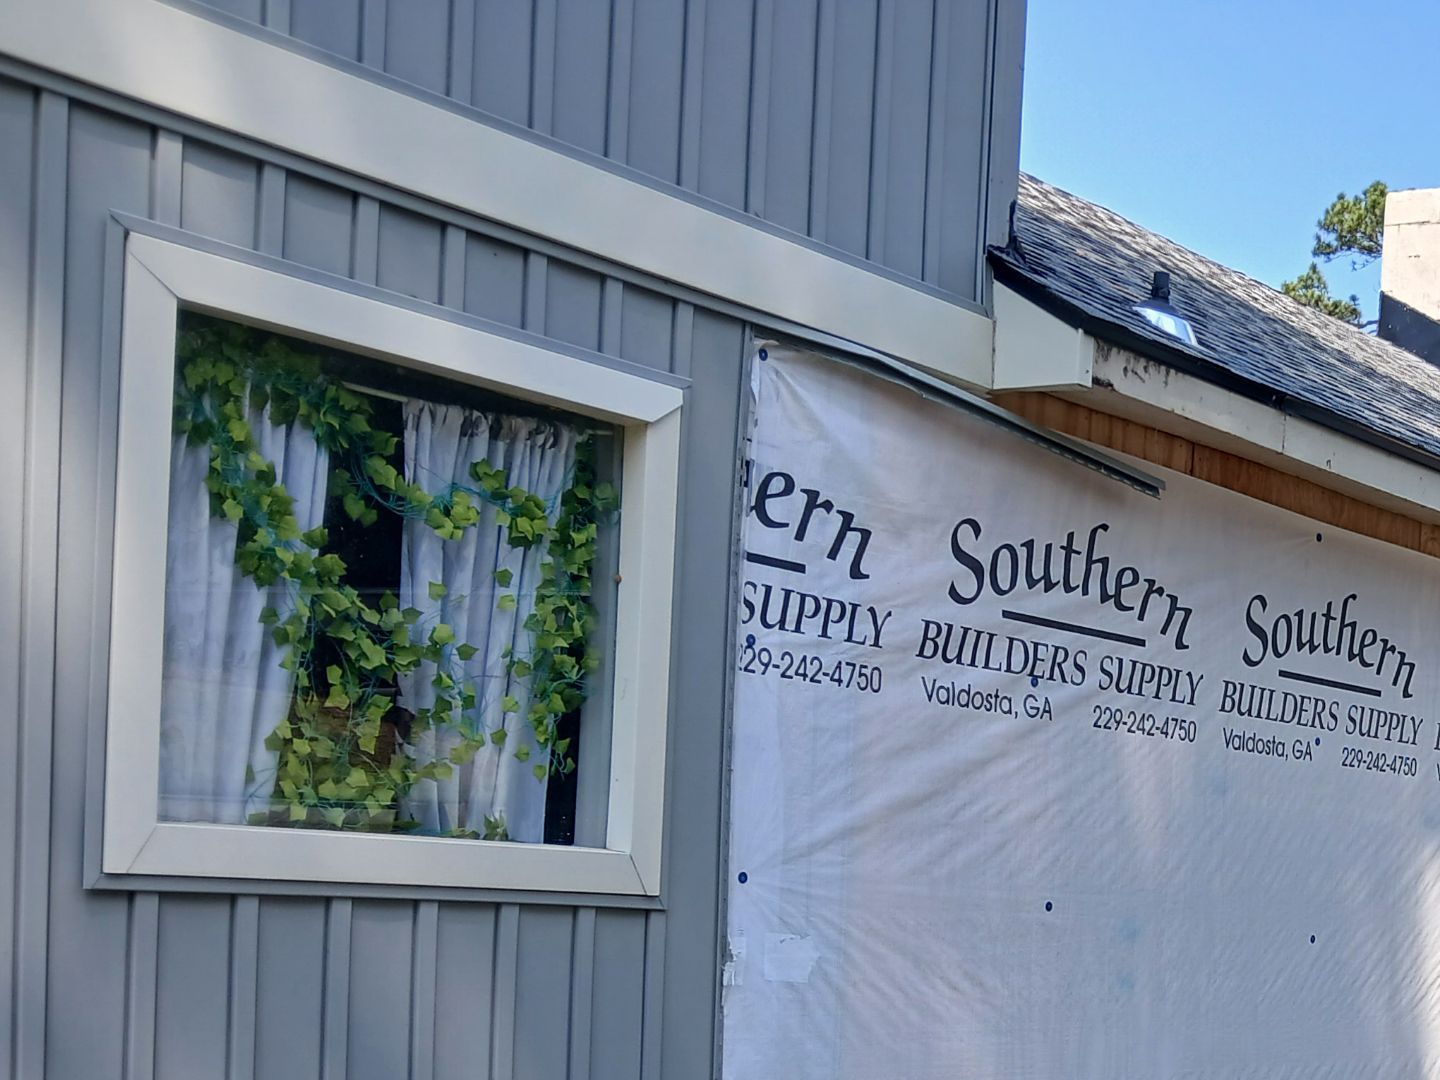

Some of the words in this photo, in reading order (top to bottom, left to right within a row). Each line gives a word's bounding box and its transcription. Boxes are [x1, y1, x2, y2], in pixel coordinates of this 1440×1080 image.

[750, 471, 872, 580] ern
[742, 580, 892, 649] SUPPLY
[947, 517, 1194, 650] Southern
[915, 618, 1088, 686] BUILDERS
[1098, 654, 1204, 706] SUPPLY
[1241, 593, 1416, 699] Southern
[921, 676, 1018, 719] Valdosta,
[1023, 696, 1053, 721] GA
[1092, 705, 1198, 743] 229-242-4750
[1218, 680, 1339, 732] BUILDERS
[1345, 704, 1424, 746] SUPPLY
[1223, 728, 1290, 760] Valdosta,
[1292, 739, 1313, 762] GA
[1341, 748, 1417, 777] 229-242-4750
